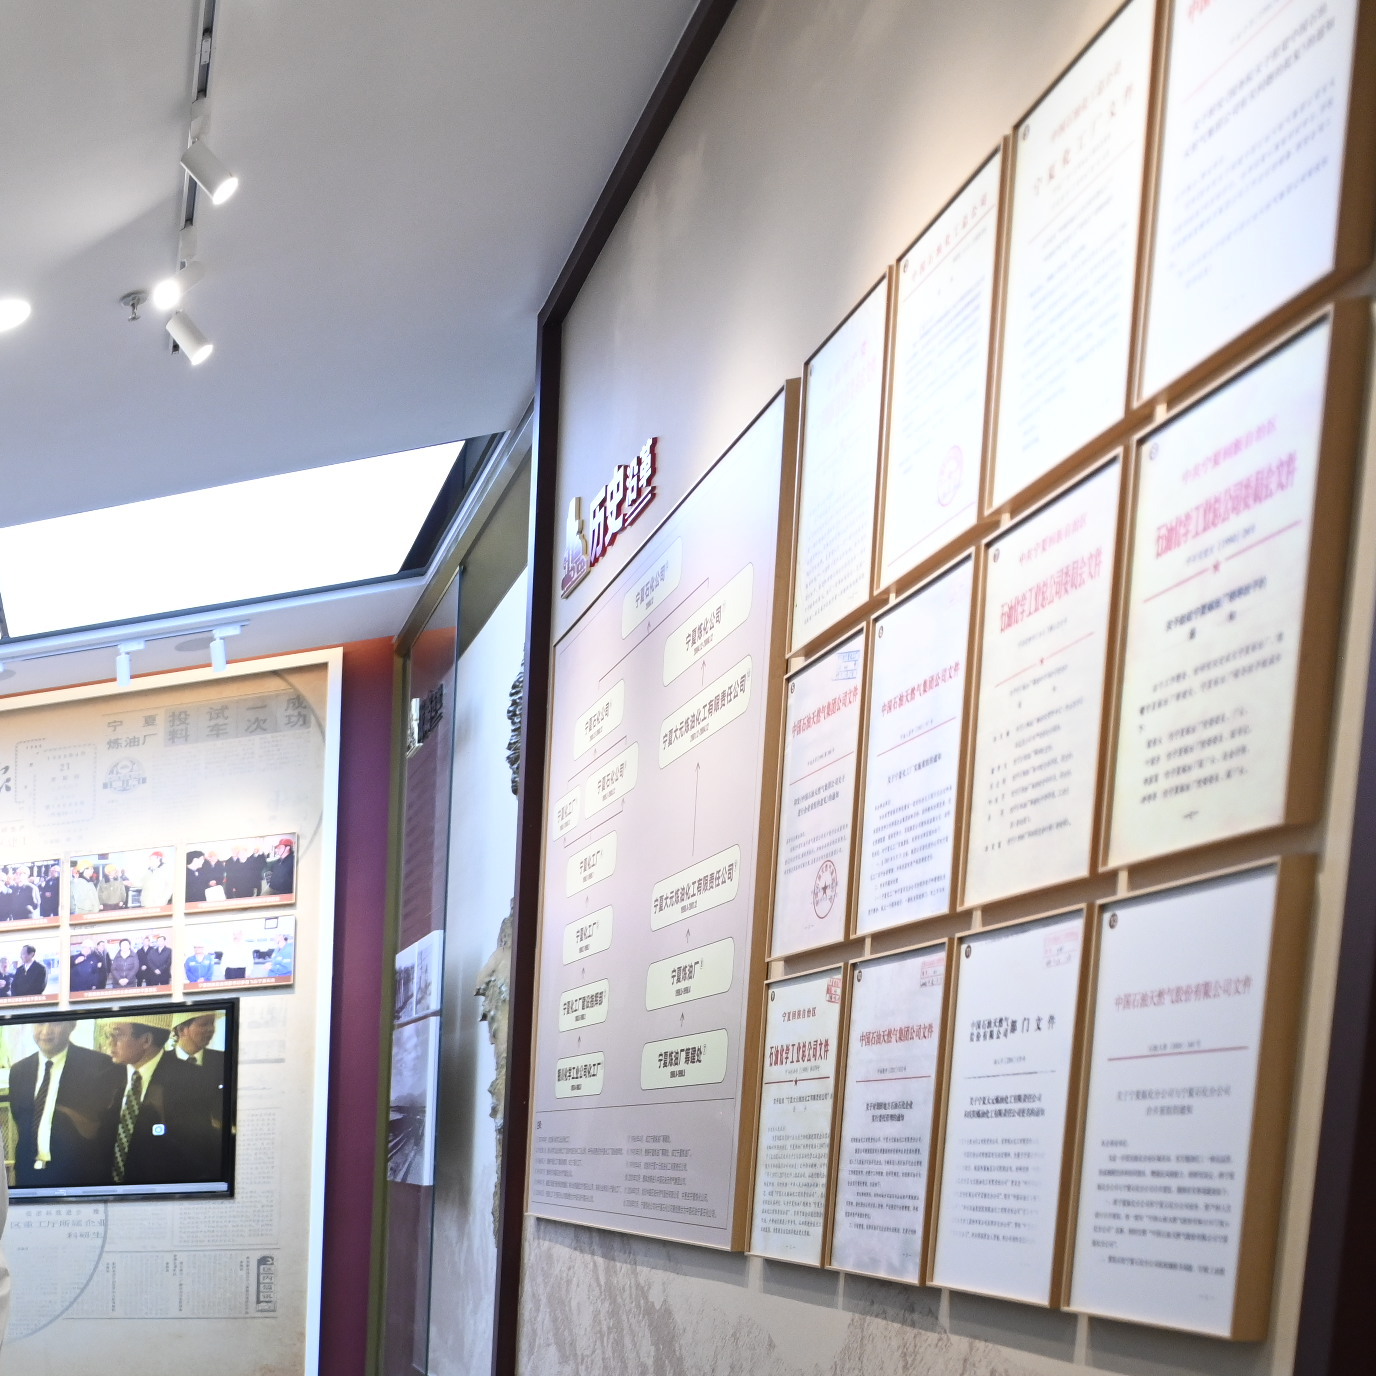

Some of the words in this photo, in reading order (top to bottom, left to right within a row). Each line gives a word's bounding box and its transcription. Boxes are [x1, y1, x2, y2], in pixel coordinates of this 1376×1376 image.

[881, 660, 960, 717] 中国石油天然气集团公司文件
[107, 713, 159, 732] 宁夏
[168, 710, 191, 744] 投料
[207, 705, 229, 738] 试车
[245, 704, 268, 733] 一次
[284, 695, 308, 728] 成功
[662, 673, 747, 751] 宁夏大元炼油化工有限责任公司
[791, 685, 859, 738] 中国石油天然气集团公司文件
[107, 732, 159, 751] 炼油厂
[653, 862, 735, 914] 宁夏大元炼油化工有限责任公司
[671, 960, 700, 985] 宁夏炼油厂
[1114, 974, 1253, 1013] 中国石油天然气股份有限公司文件
[859, 1022, 934, 1048] 中国石油天然气集团公司文件
[768, 1038, 830, 1068] 石油化学工业总公司文件
